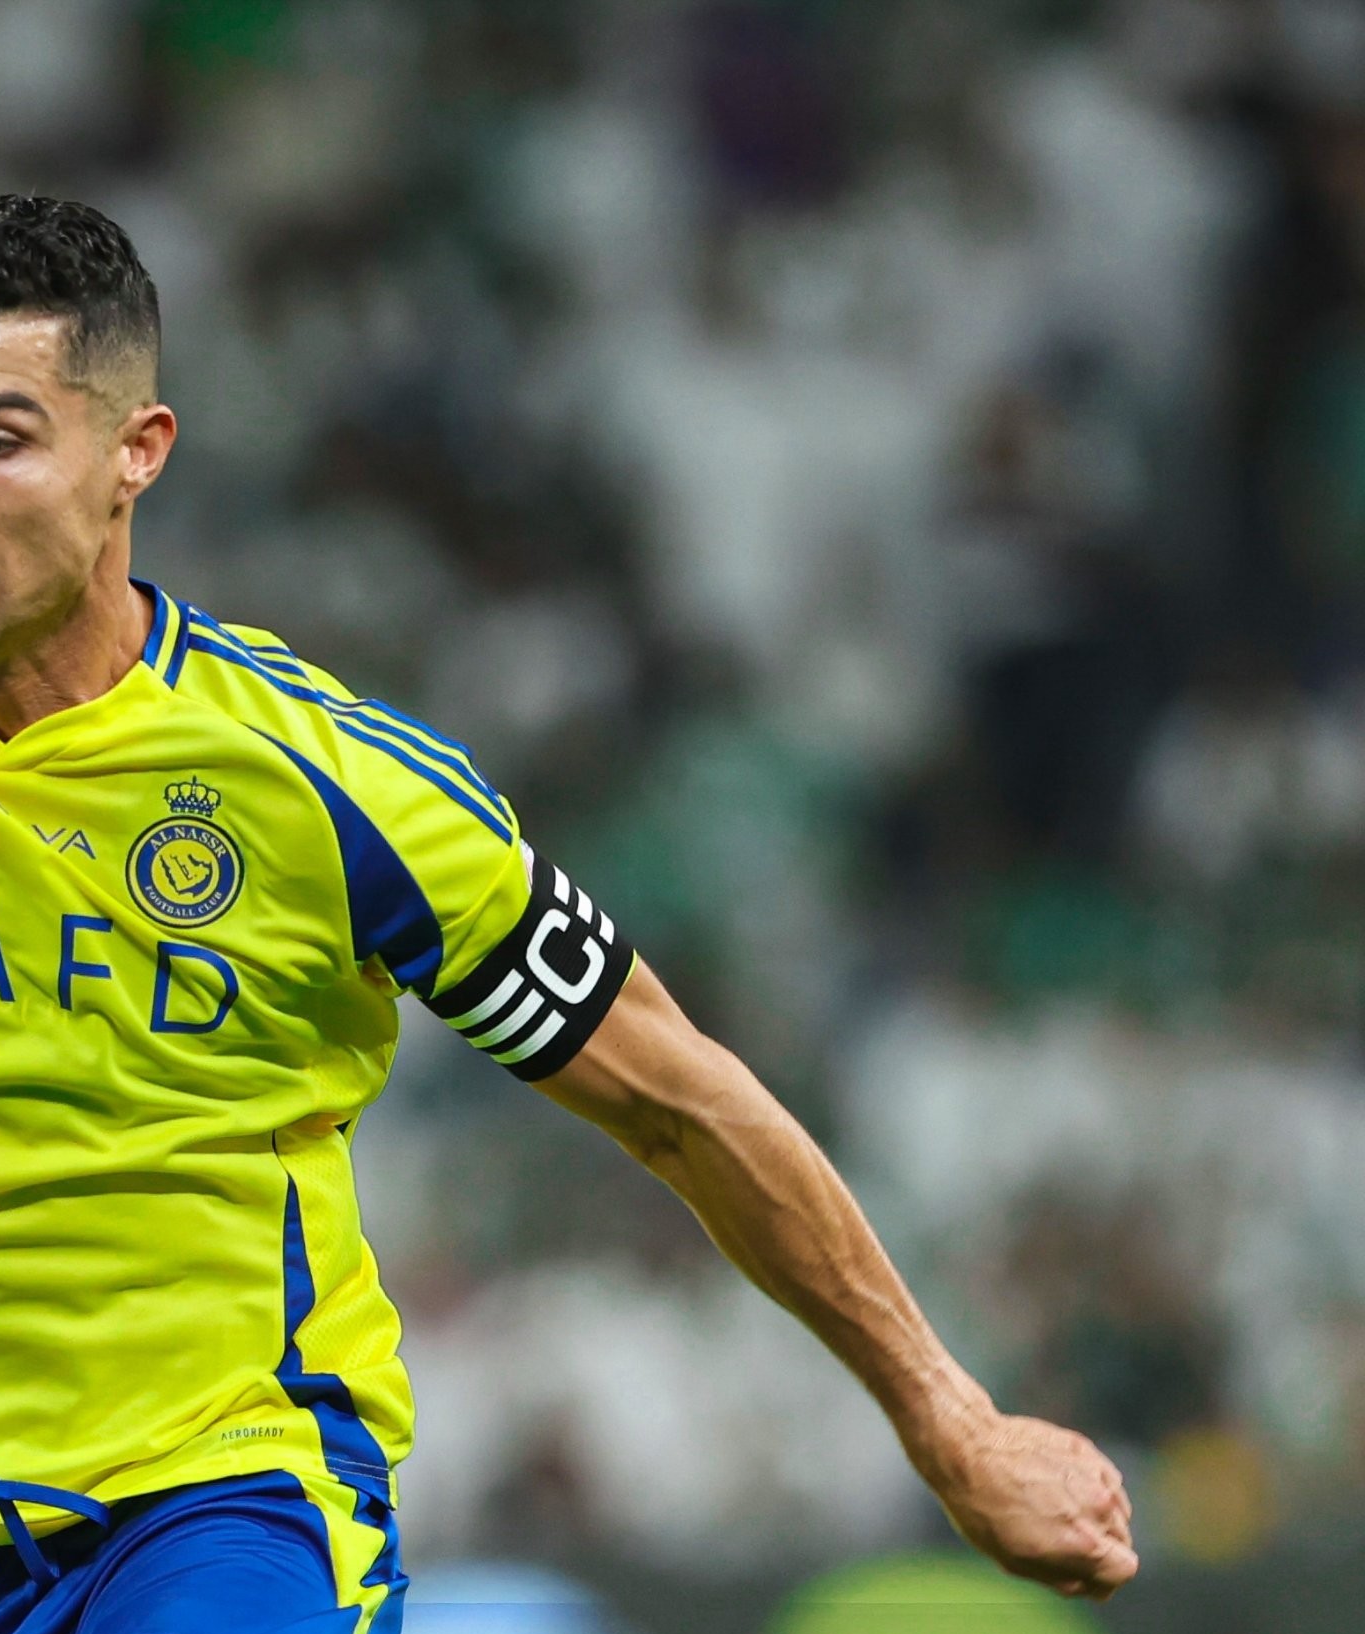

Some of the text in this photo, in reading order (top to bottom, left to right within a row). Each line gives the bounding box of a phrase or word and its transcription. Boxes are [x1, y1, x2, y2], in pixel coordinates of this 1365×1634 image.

[149, 826, 227, 859] AL NASSR
[145, 885, 223, 917] FOOTBALL CLUB
[526, 908, 606, 1005] C
[221, 1427, 285, 1441] AEROREADY
